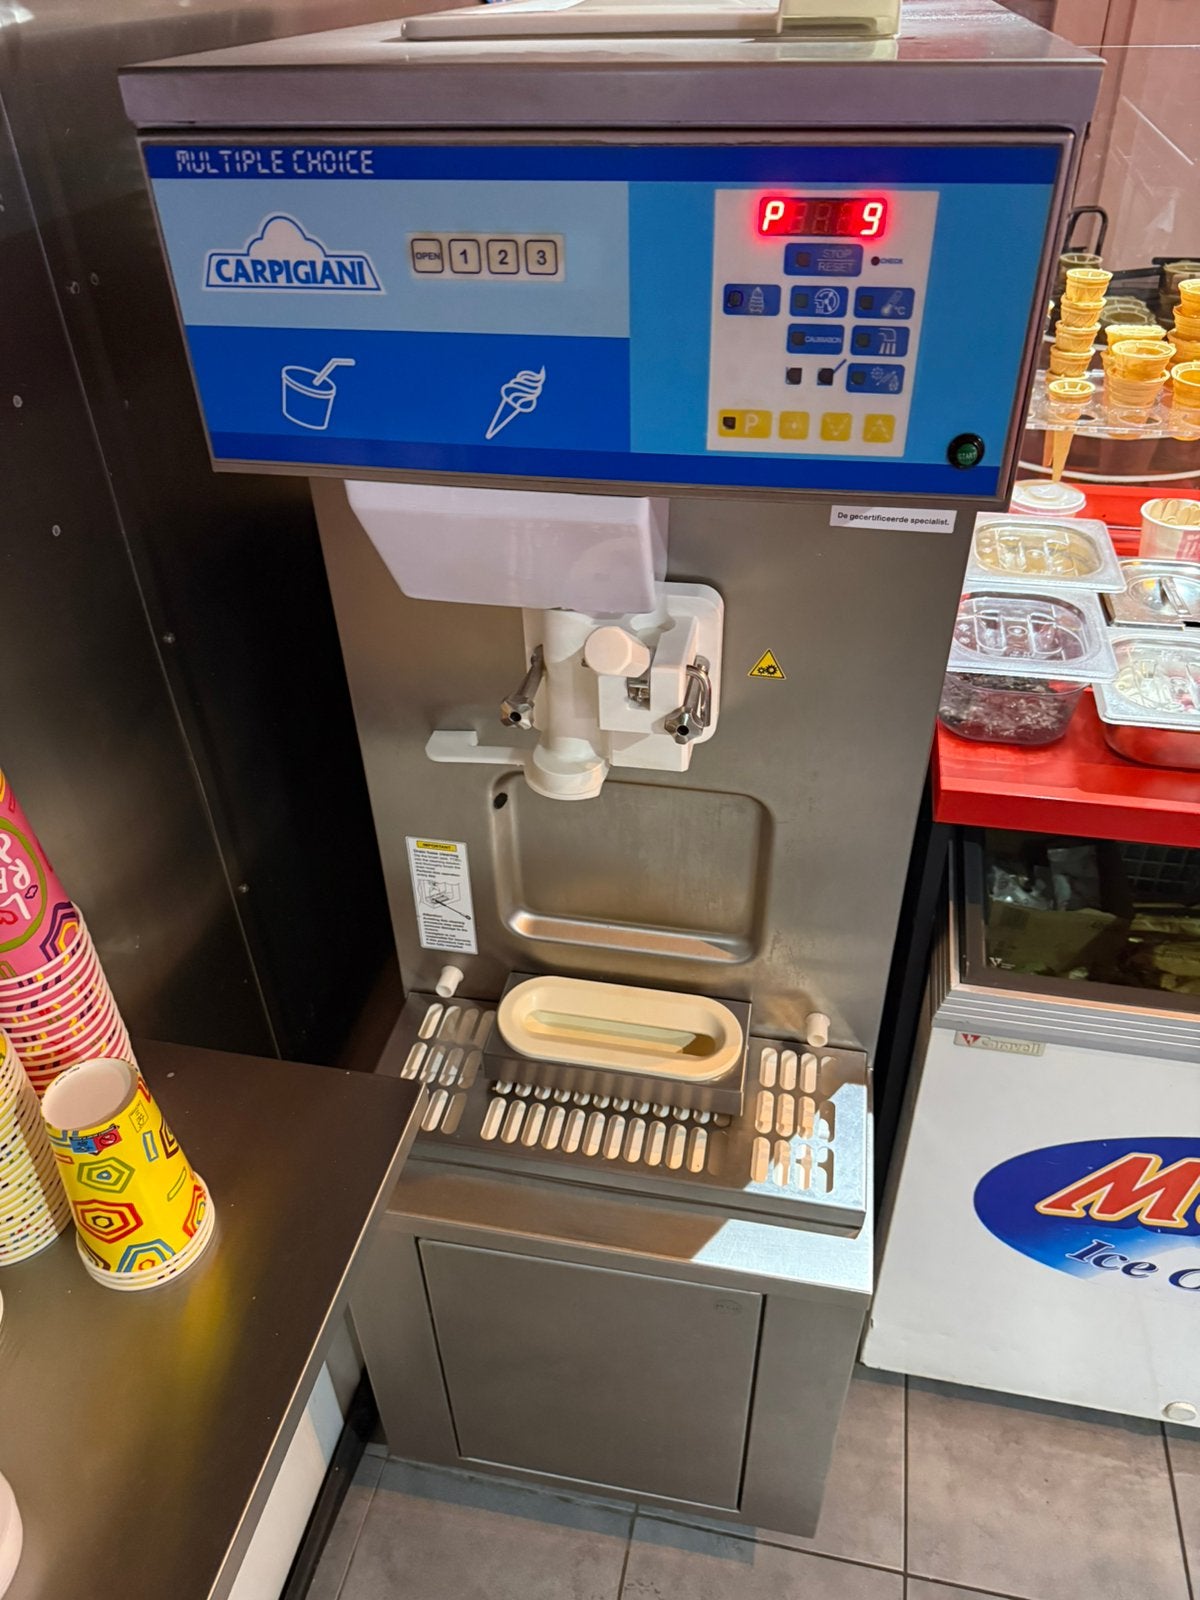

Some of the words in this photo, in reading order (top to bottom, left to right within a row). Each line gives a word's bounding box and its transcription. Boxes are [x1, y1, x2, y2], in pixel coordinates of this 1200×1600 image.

[175, 150, 285, 174] MULTIPLE
[292, 150, 375, 174] CHOICE
[762, 201, 785, 231] P
[415, 252, 441, 260] OPEN
[459, 249, 468, 264] 1
[498, 250, 509, 265] 2
[536, 250, 547, 265] 3
[822, 248, 852, 258] STOP
[215, 258, 366, 285] CARPIGIANI
[818, 261, 854, 272] RESET
[849, 513, 909, 524] gecertificeerde
[910, 517, 950, 525] specialist.
[1035, 1152, 1200, 1229] M
[1065, 1239, 1158, 1279] Ice
